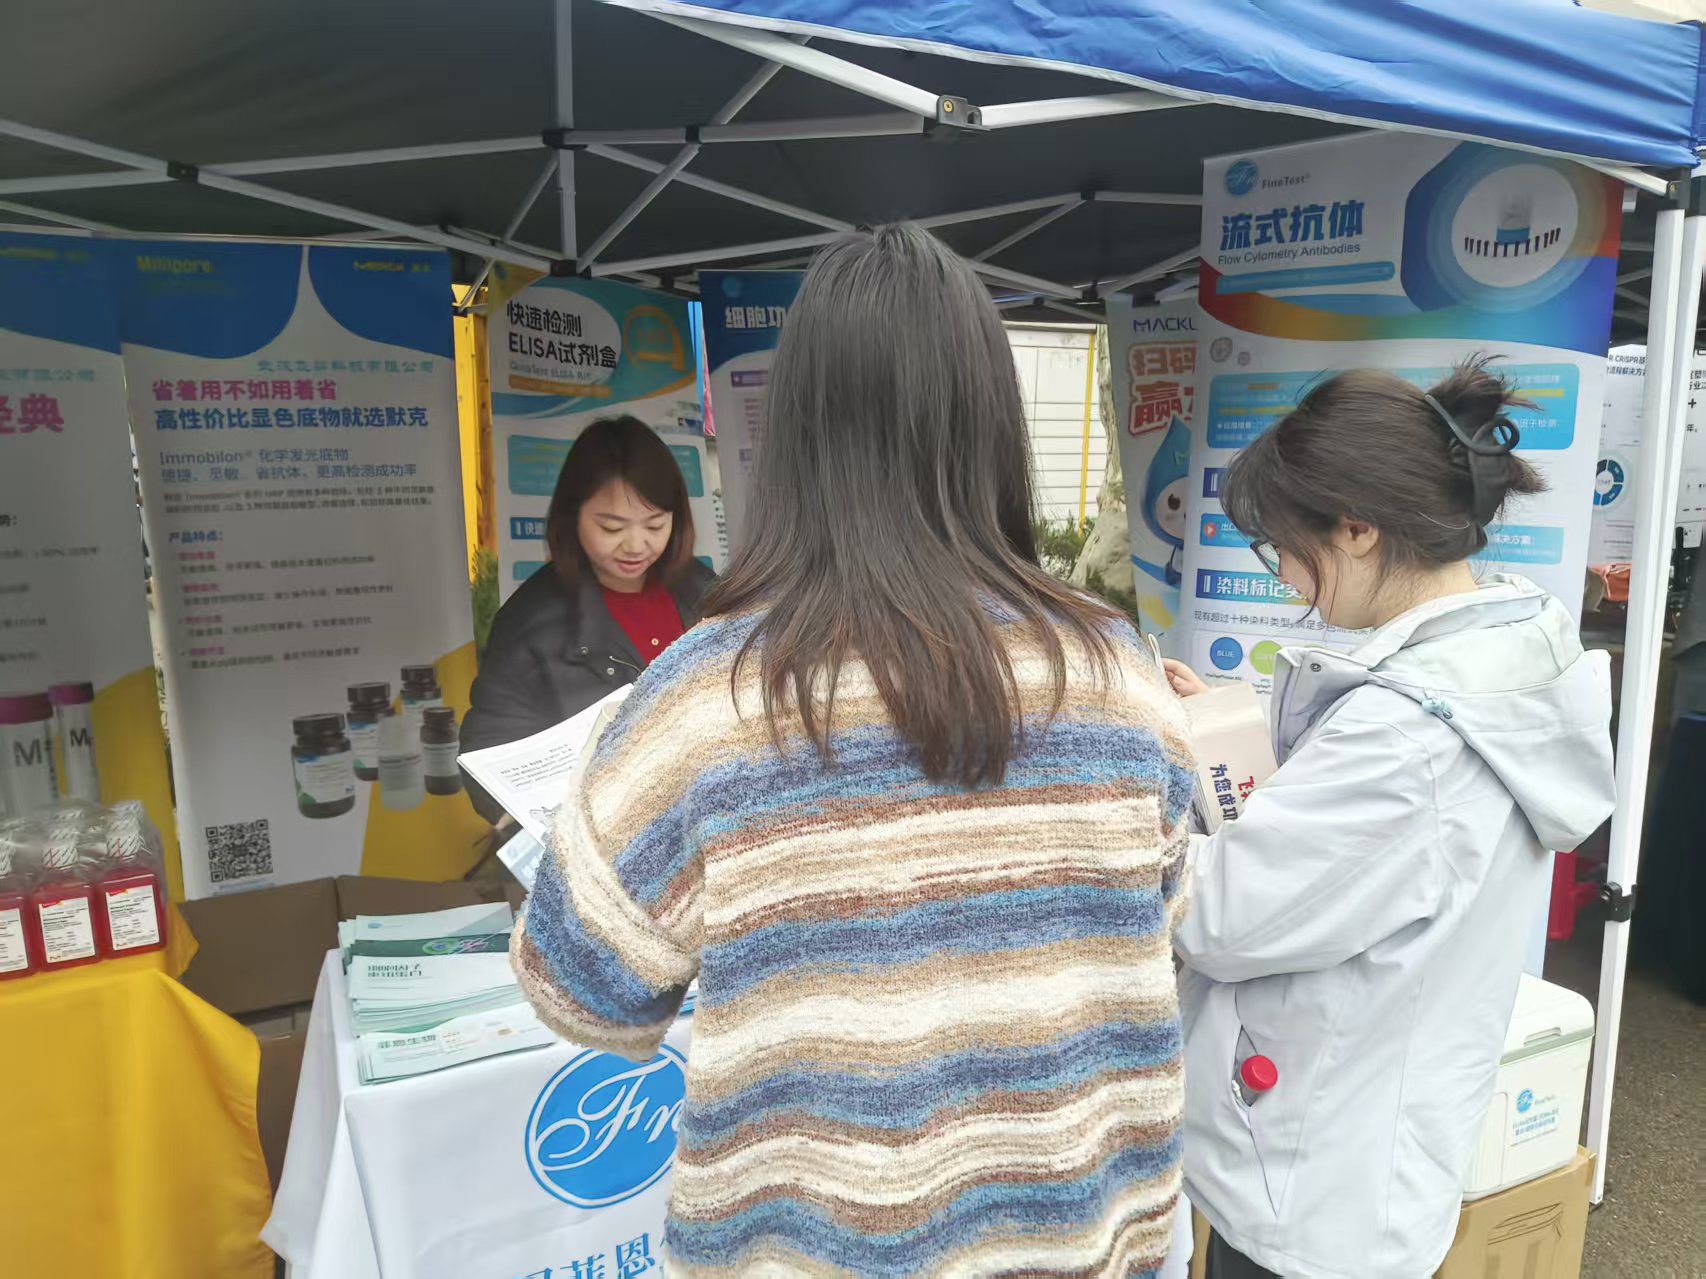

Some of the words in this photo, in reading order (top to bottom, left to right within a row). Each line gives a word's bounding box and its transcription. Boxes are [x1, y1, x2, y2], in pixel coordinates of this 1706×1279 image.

[1220, 199, 1365, 251] 流式抗体
[1218, 255, 1241, 265] Flow
[1300, 243, 1361, 257] Antibodies
[507, 300, 582, 337] 快速检测
[725, 306, 787, 329] 细胞功
[509, 332, 617, 369] ELISA试剂盒
[1134, 345, 1197, 377] 扫码
[151, 379, 337, 401] 省着用不如用着省
[1135, 381, 1195, 428] 赢
[154, 406, 429, 431] 高性价比显色底物就选默克
[258, 448, 349, 464] 化学发光底物
[511, 1232, 666, 1279] 菲恩
